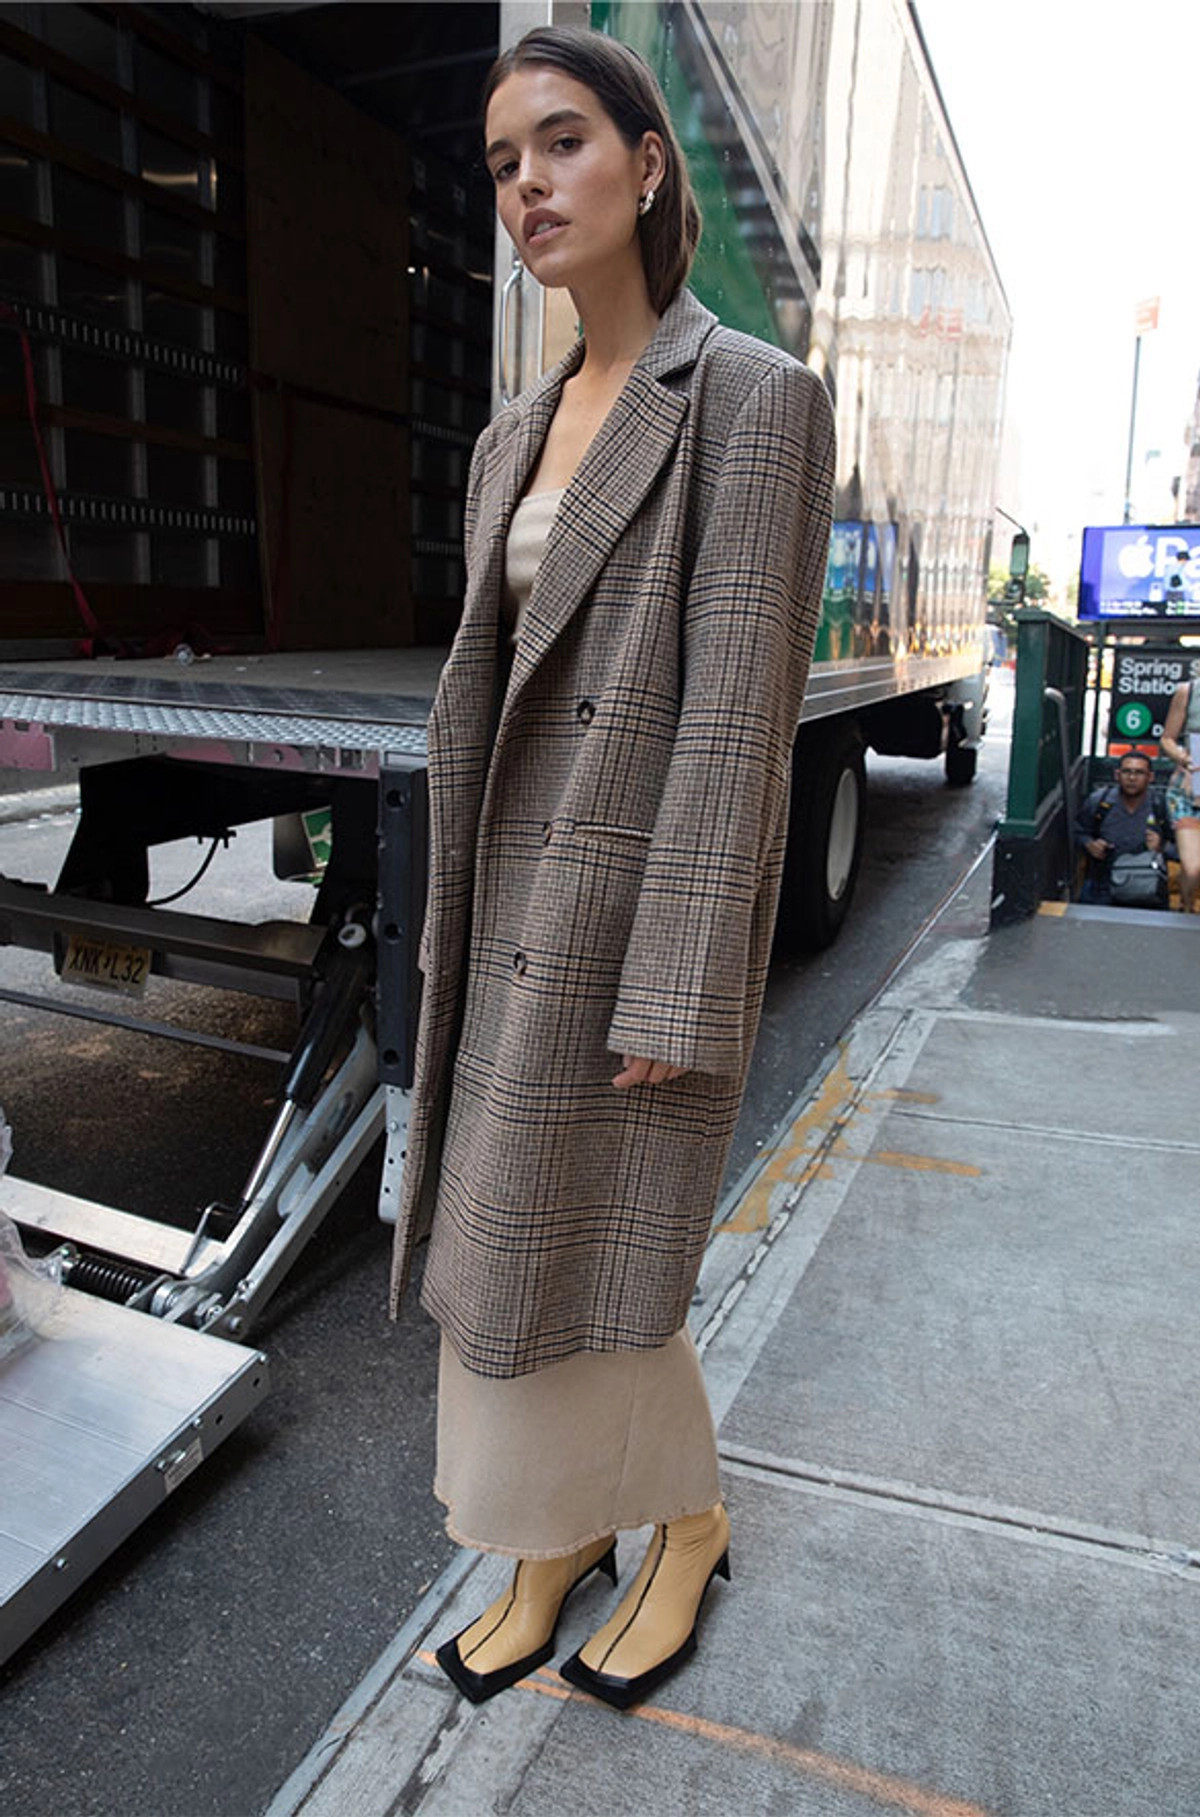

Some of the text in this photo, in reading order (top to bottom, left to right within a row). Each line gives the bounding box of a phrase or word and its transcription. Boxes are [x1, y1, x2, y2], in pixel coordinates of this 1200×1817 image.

[1120, 657, 1200, 679] Spring S
[1118, 677, 1177, 695] Statio
[1126, 709, 1142, 730] 6
